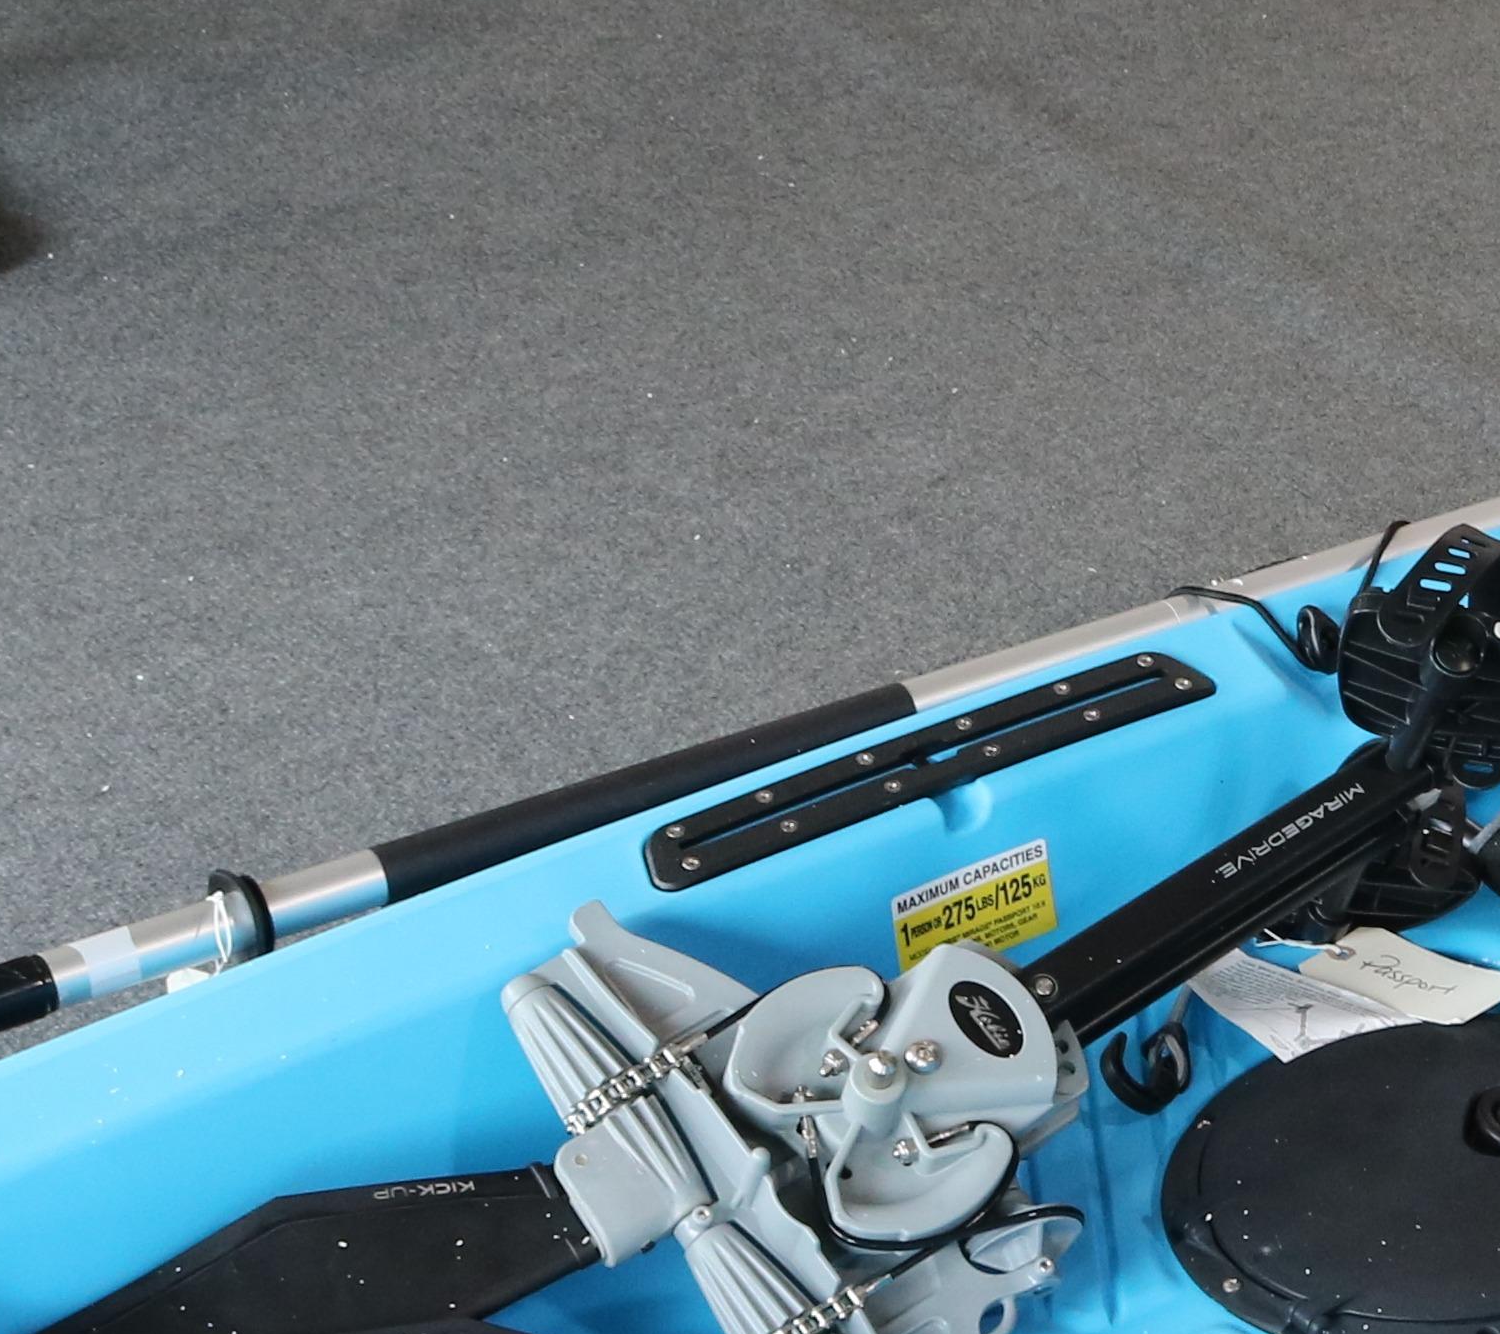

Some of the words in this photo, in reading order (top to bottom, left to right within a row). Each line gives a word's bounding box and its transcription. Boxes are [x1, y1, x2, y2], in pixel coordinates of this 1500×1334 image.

[896, 876, 960, 915] MAXIMUM
[962, 844, 1044, 886] CAPACITIES
[372, 1180, 476, 1200] KICK-UP
